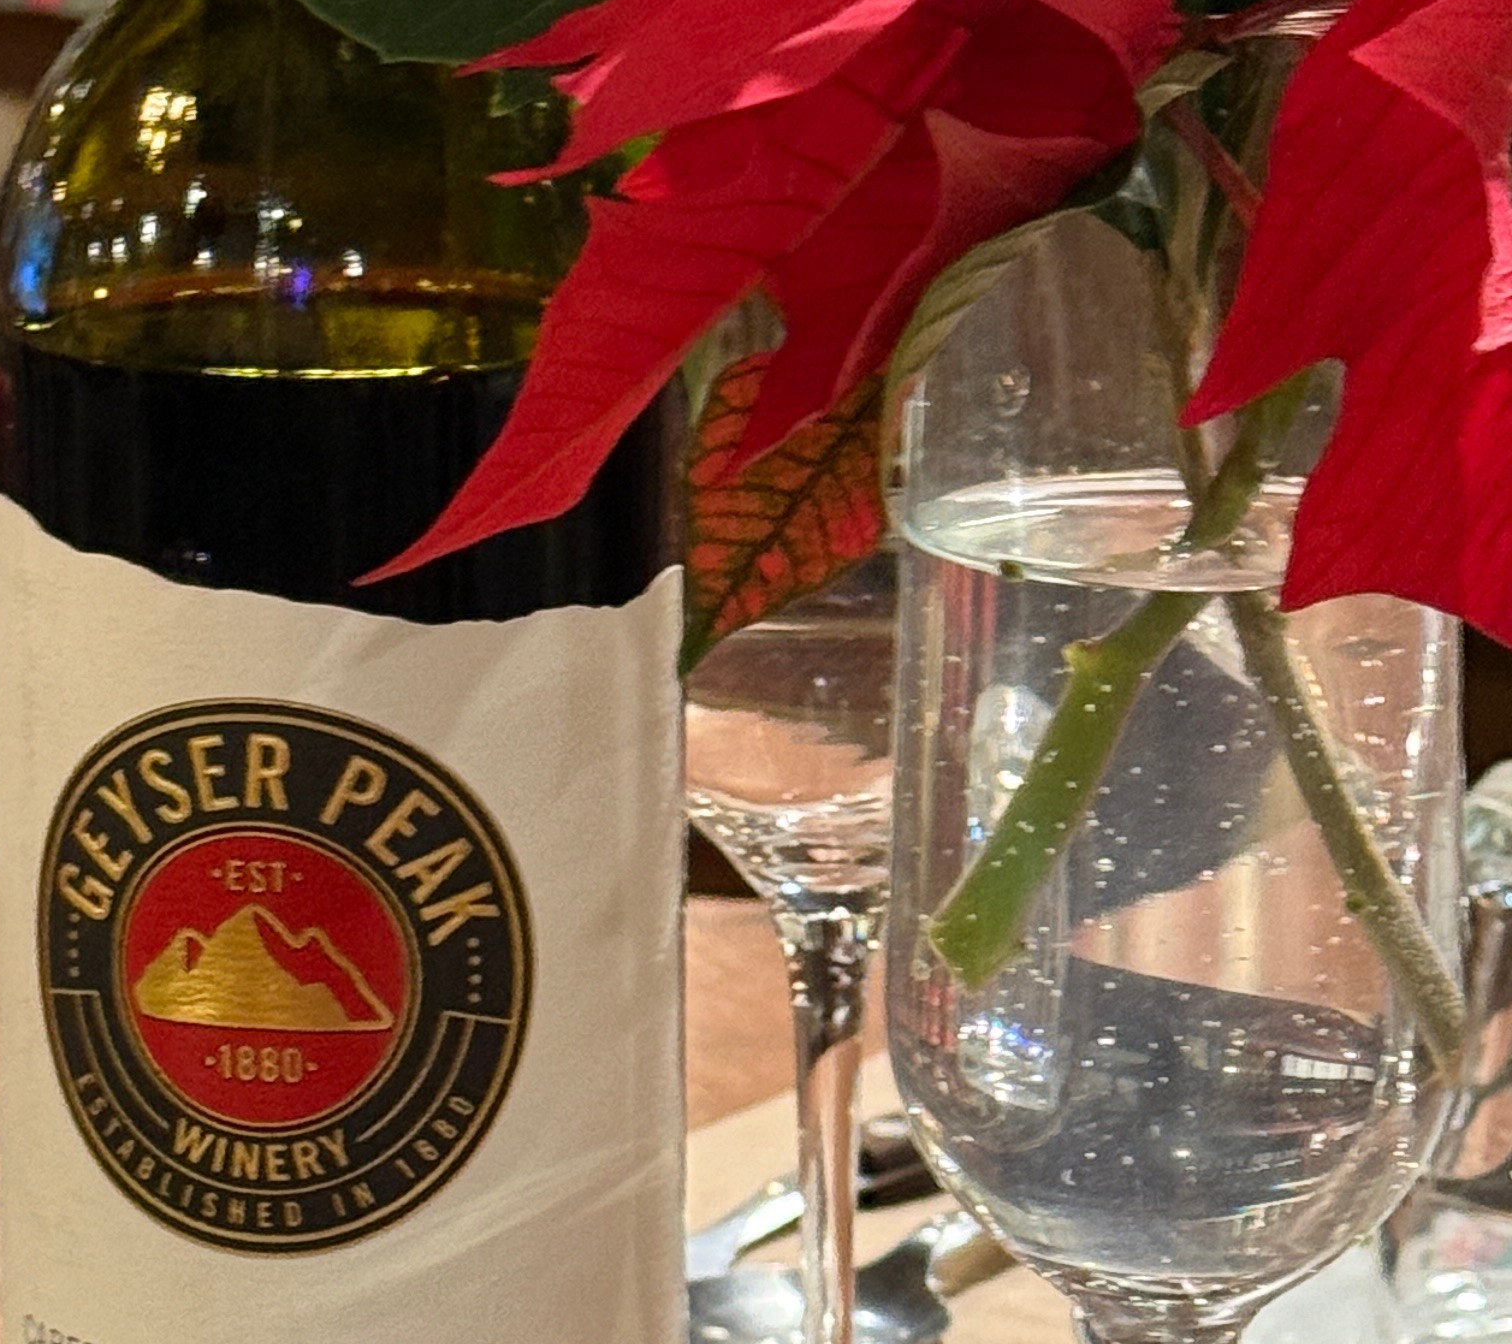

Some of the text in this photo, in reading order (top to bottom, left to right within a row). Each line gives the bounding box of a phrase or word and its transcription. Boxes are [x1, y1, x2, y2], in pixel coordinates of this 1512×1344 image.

[59, 733, 500, 946] GEYSER PEAK
[75, 1072, 303, 1229] ESTABLISHED
[331, 1182, 376, 1216] IN
[172, 1117, 349, 1182] WINERY
